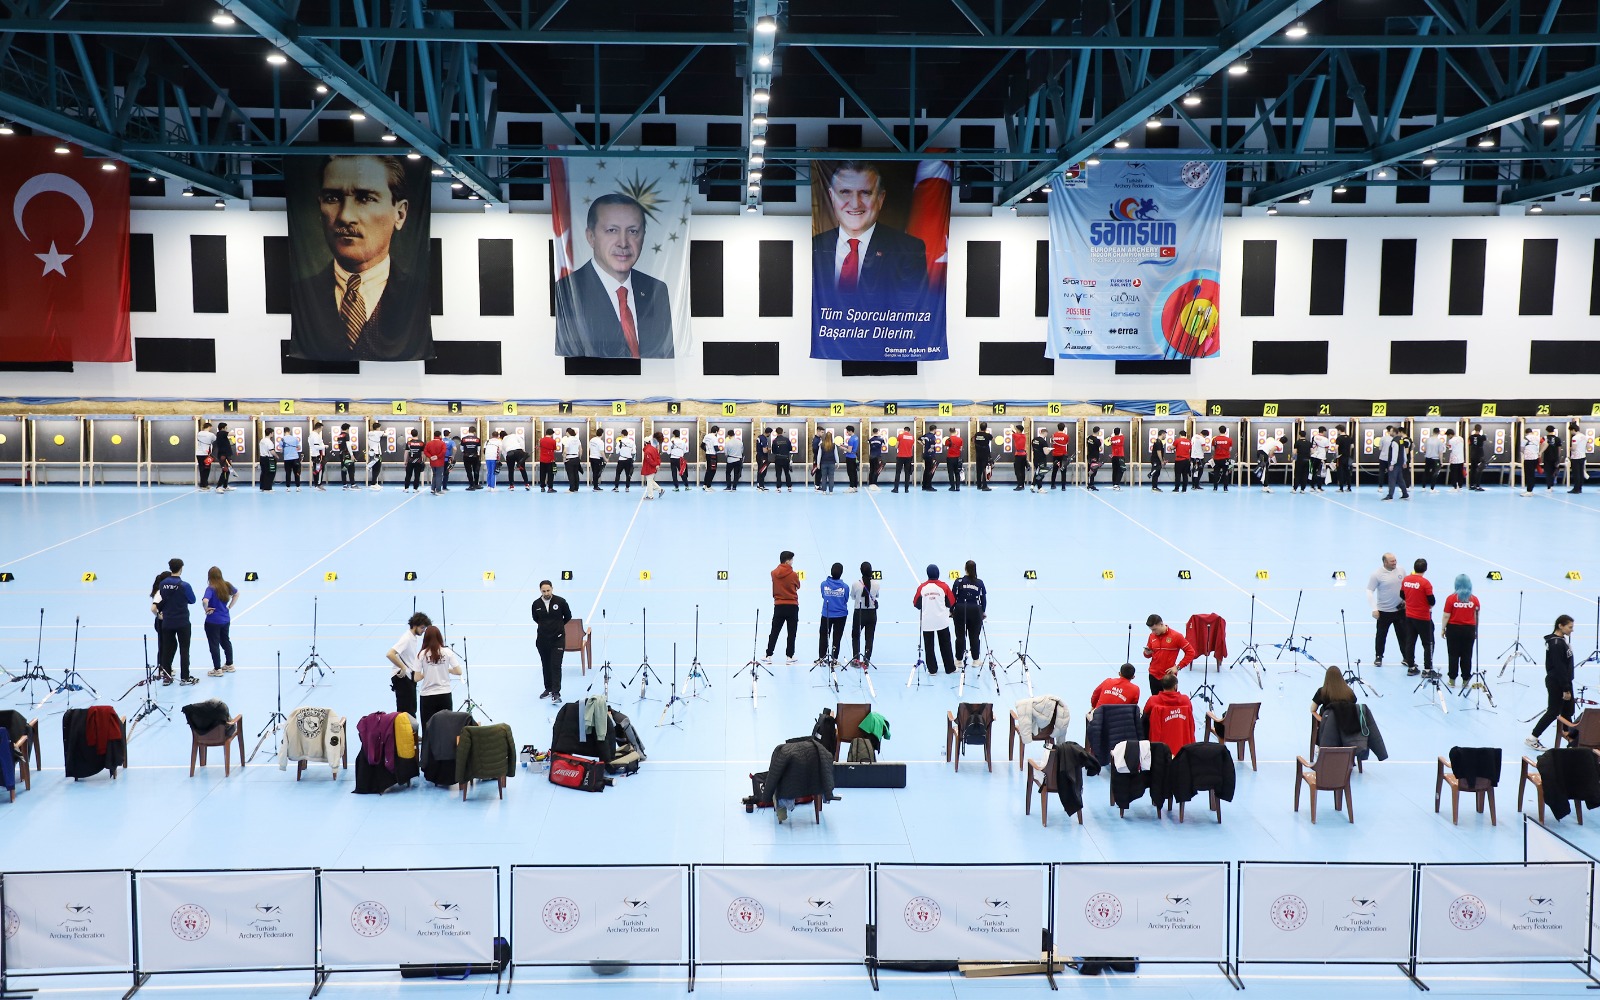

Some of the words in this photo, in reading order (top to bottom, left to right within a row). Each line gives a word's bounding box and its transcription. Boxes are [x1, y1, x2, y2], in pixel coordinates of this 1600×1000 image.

[820, 308, 842, 320] Tüm
[846, 308, 931, 322] Sporcularımıza
[818, 326, 870, 340] Başarılar
[872, 326, 916, 339] Dilerim.
[228, 402, 234, 411] 1
[284, 402, 290, 411] 2
[339, 403, 345, 413] 3
[396, 403, 402, 412] 4
[452, 403, 458, 413] 5
[508, 404, 513, 413] 6
[563, 404, 569, 413] 7
[616, 404, 622, 413] 8
[671, 404, 678, 414] 9
[724, 405, 733, 414] 10
[779, 405, 788, 414] 11
[832, 405, 842, 414] 12
[886, 405, 896, 414] 13
[941, 405, 950, 414] 14
[994, 404, 1004, 414] 15
[1050, 405, 1059, 414] 16
[1103, 404, 1113, 414] 17
[1157, 405, 1167, 414] 18
[1211, 405, 1221, 414] 19
[1266, 405, 1276, 414] 20
[1320, 404, 1330, 414] 21
[1374, 405, 1384, 414] 22
[1428, 406, 1439, 414] 23
[1484, 405, 1494, 414] 24
[1538, 405, 1550, 414] 25
